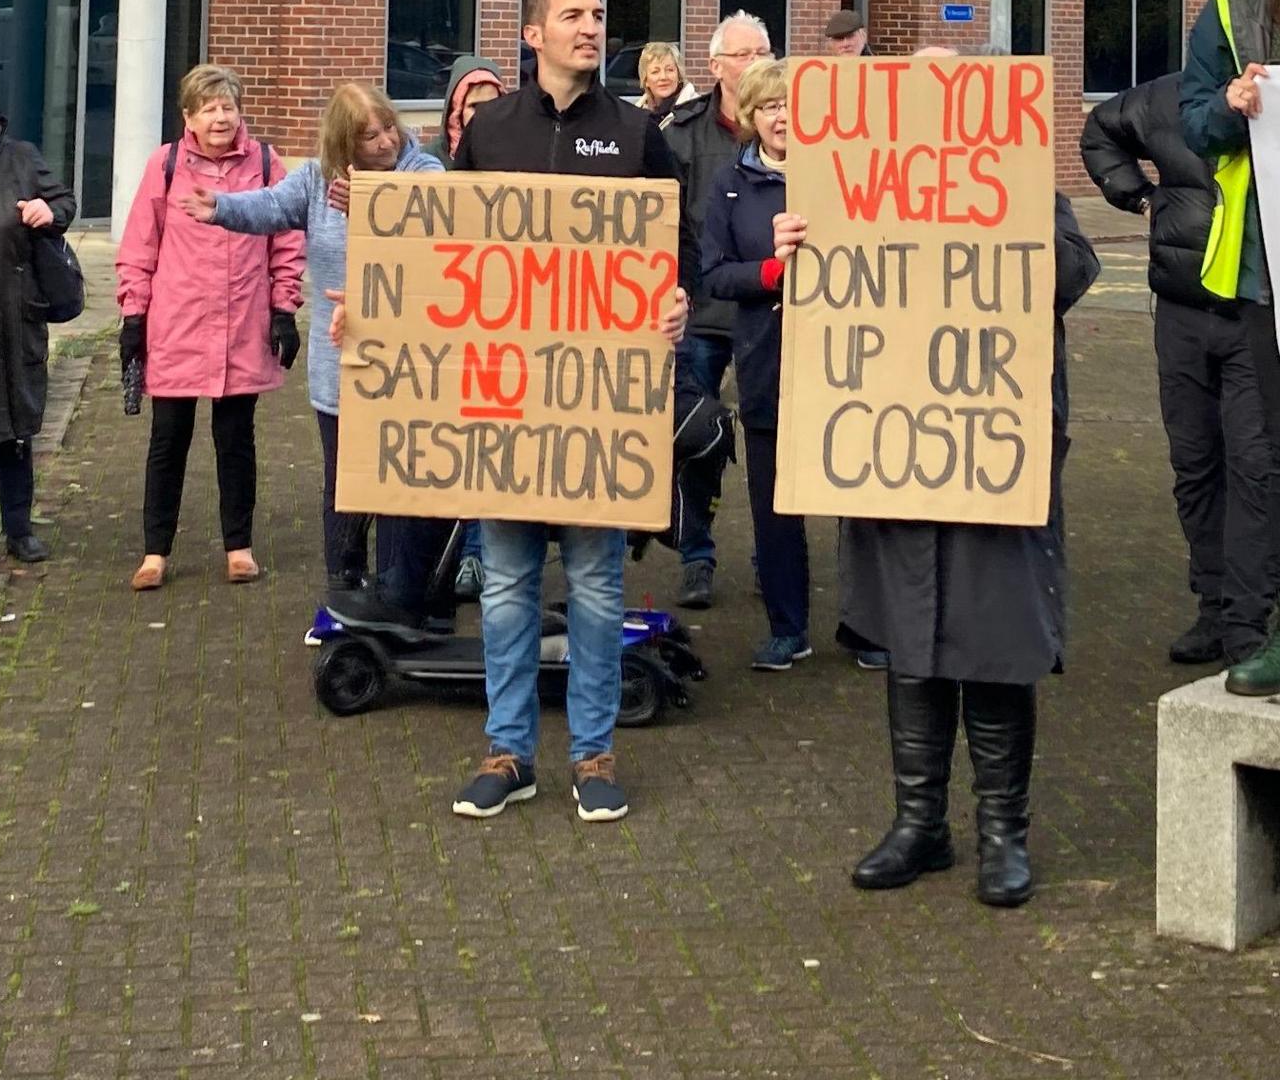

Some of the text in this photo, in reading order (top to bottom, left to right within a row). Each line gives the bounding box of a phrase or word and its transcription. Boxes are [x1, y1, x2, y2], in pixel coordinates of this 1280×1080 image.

[792, 60, 1048, 147] CUT YOUR
[368, 182, 664, 247] CAN YOU SHOP
[832, 144, 1008, 227] WAGES
[361, 262, 404, 319] IN
[944, 241, 1046, 313] PUT
[353, 339, 675, 415] SAY NO TO NEW
[824, 324, 1022, 400] UP OUR
[379, 420, 654, 501] RESTRICTIONS
[822, 400, 1025, 494] COSTS
